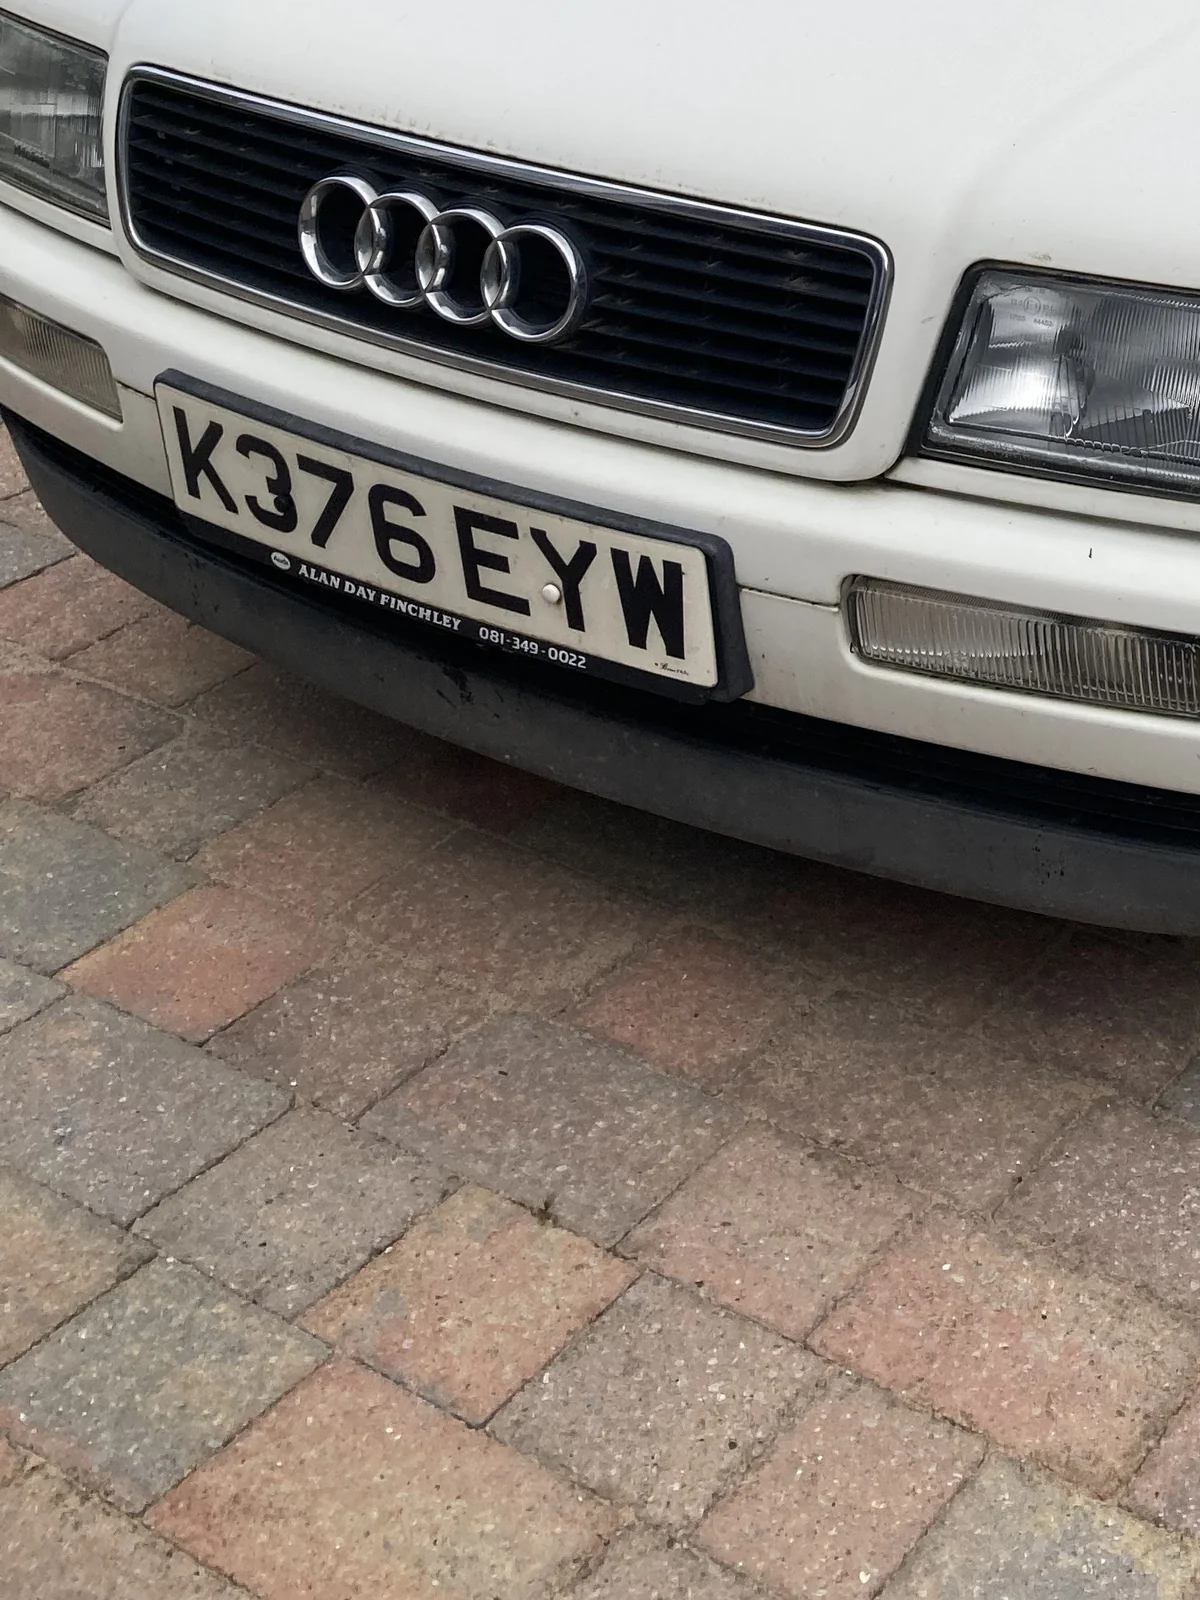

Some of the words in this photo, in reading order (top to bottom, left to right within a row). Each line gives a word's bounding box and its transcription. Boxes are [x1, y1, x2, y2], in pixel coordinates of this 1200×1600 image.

[299, 563, 341, 590] ALAN
[343, 579, 378, 603] DAY
[379, 592, 462, 631] FINCHLEY
[479, 627, 587, 669] 081-349-0022
